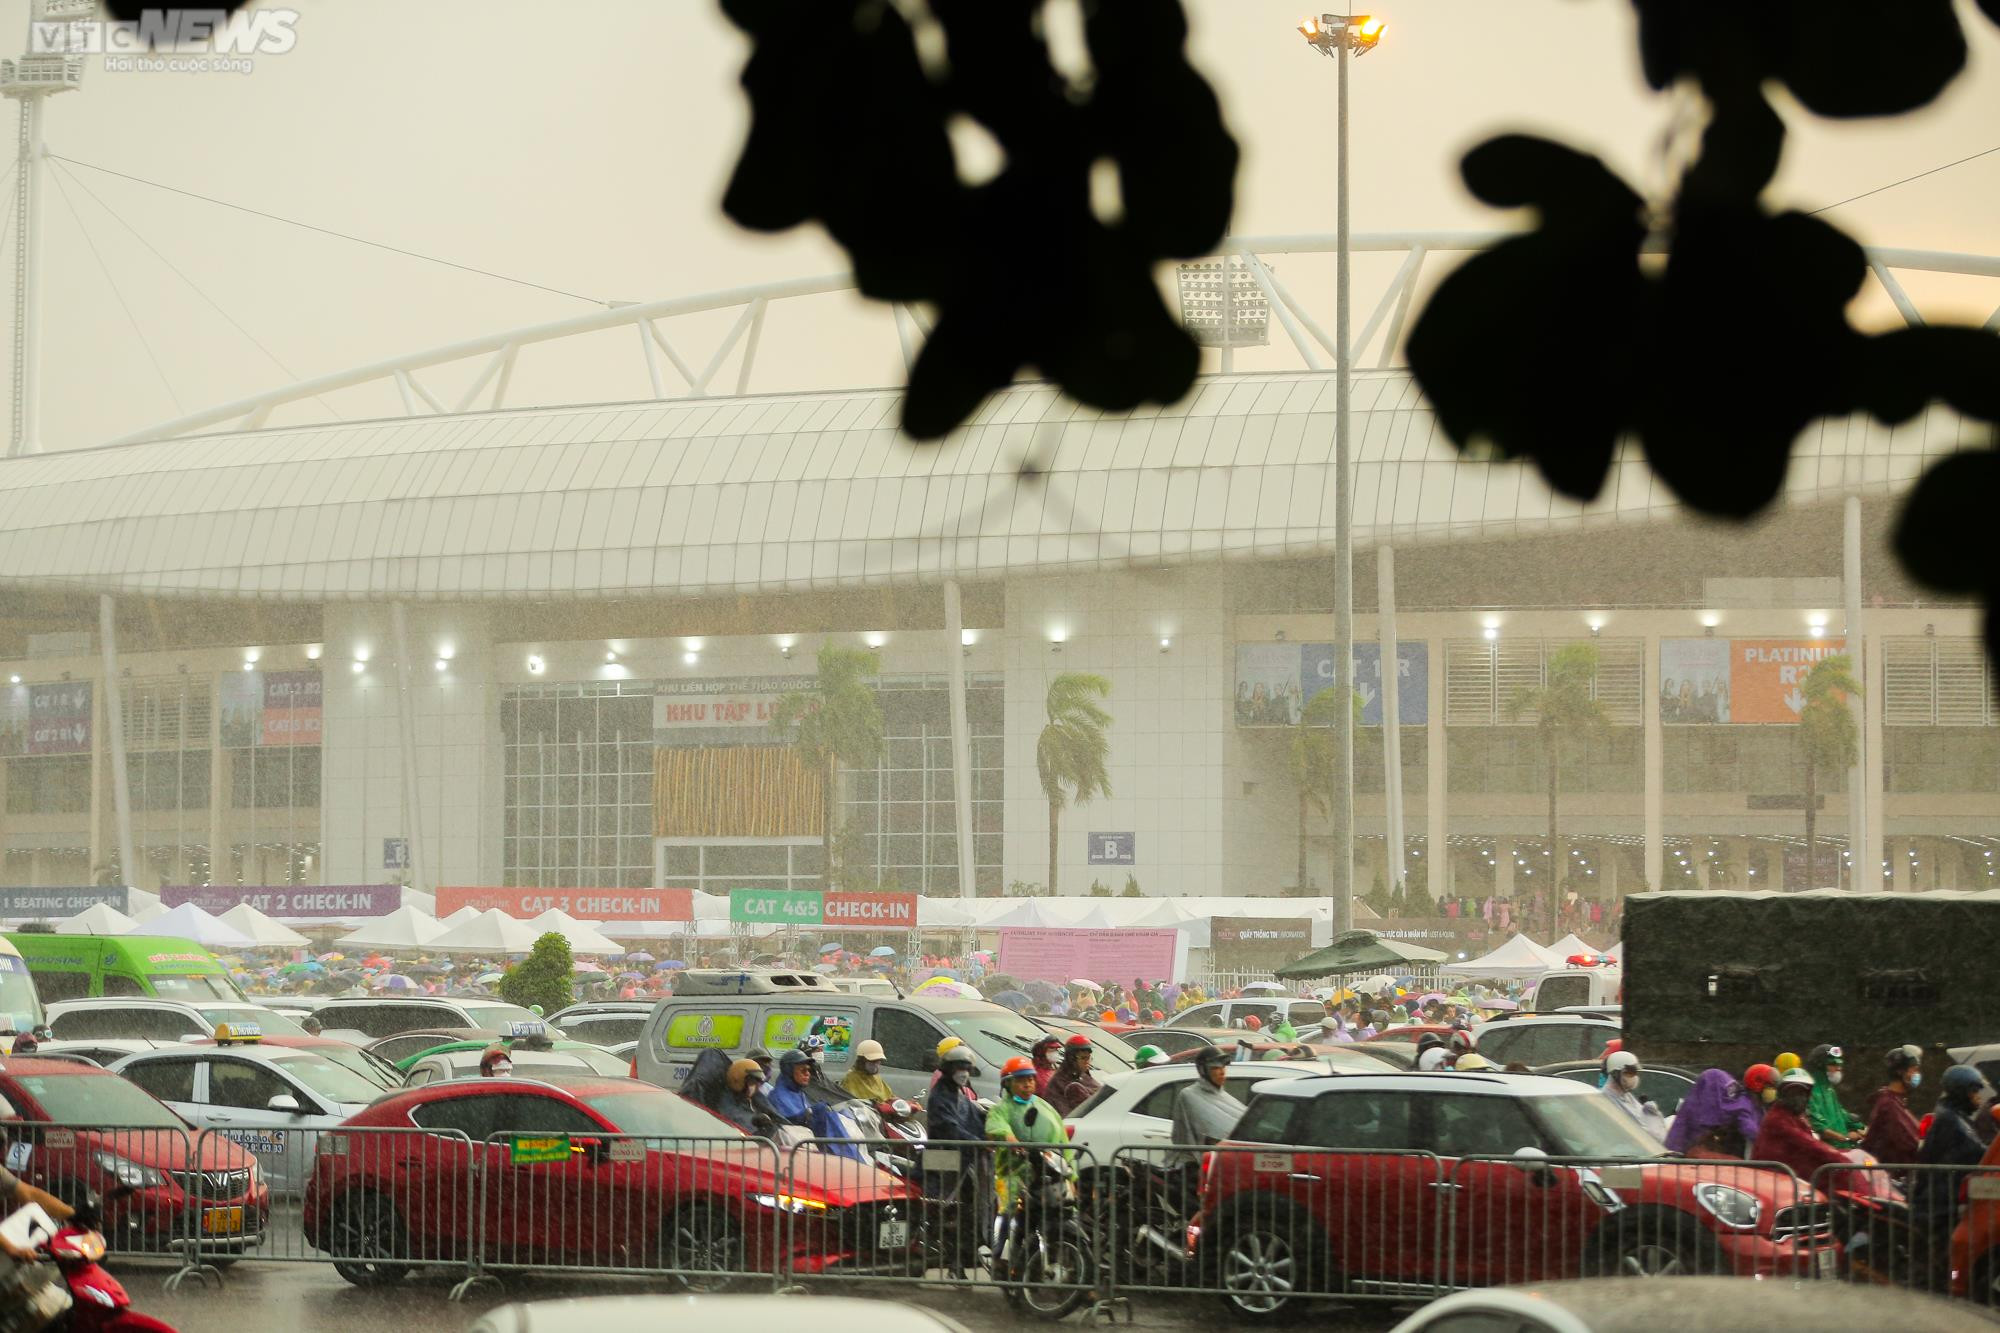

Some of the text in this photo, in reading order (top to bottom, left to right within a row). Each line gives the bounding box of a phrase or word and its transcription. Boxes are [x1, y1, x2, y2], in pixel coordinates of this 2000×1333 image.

[1317, 659, 1362, 678] CT
[666, 703, 706, 721] KHU
[1104, 840, 1118, 859] B
[14, 896, 64, 909] SEATING
[276, 894, 287, 910] 2
[293, 893, 372, 910] CHECK-IN
[520, 896, 660, 914] CAT 3 CHECK-IN
[744, 899, 910, 919] CAT 4&5 CHECK-IN
